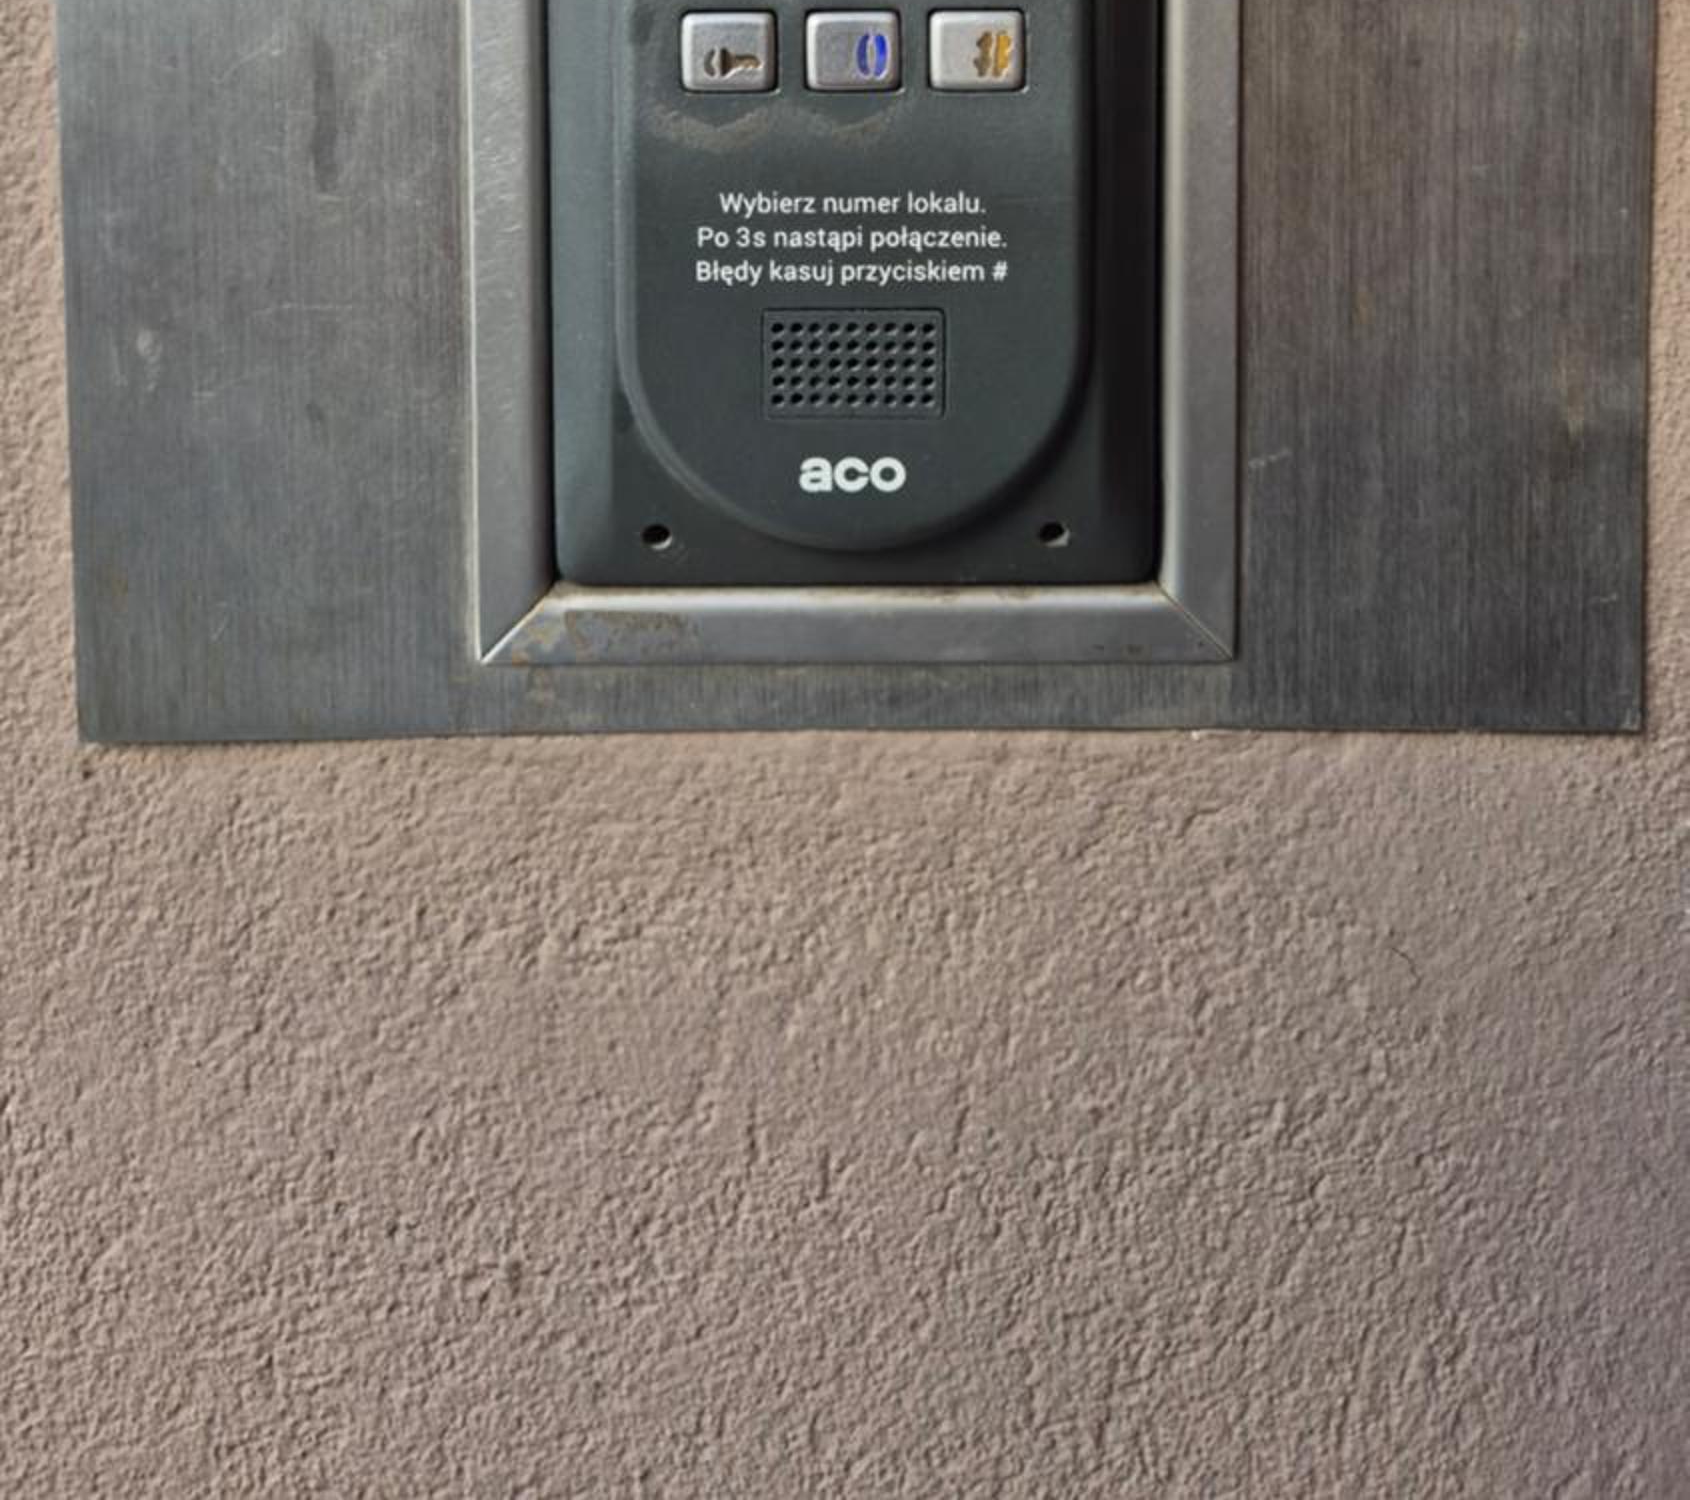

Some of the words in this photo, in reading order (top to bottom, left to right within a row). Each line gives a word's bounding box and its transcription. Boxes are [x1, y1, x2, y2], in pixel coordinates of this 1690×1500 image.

[856, 32, 888, 78] 0
[719, 192, 816, 218] Wybierz
[823, 196, 900, 214] numer
[907, 191, 987, 214] lokalu.
[697, 227, 730, 247] Po
[736, 227, 767, 248] 3s
[774, 226, 863, 252] nastąpi
[870, 226, 1008, 252] połączenie.
[696, 261, 762, 287] Błędy
[770, 261, 833, 287] kasuj
[841, 261, 985, 287] przyciskiem
[992, 262, 1009, 282] #
[799, 456, 907, 492] aco
